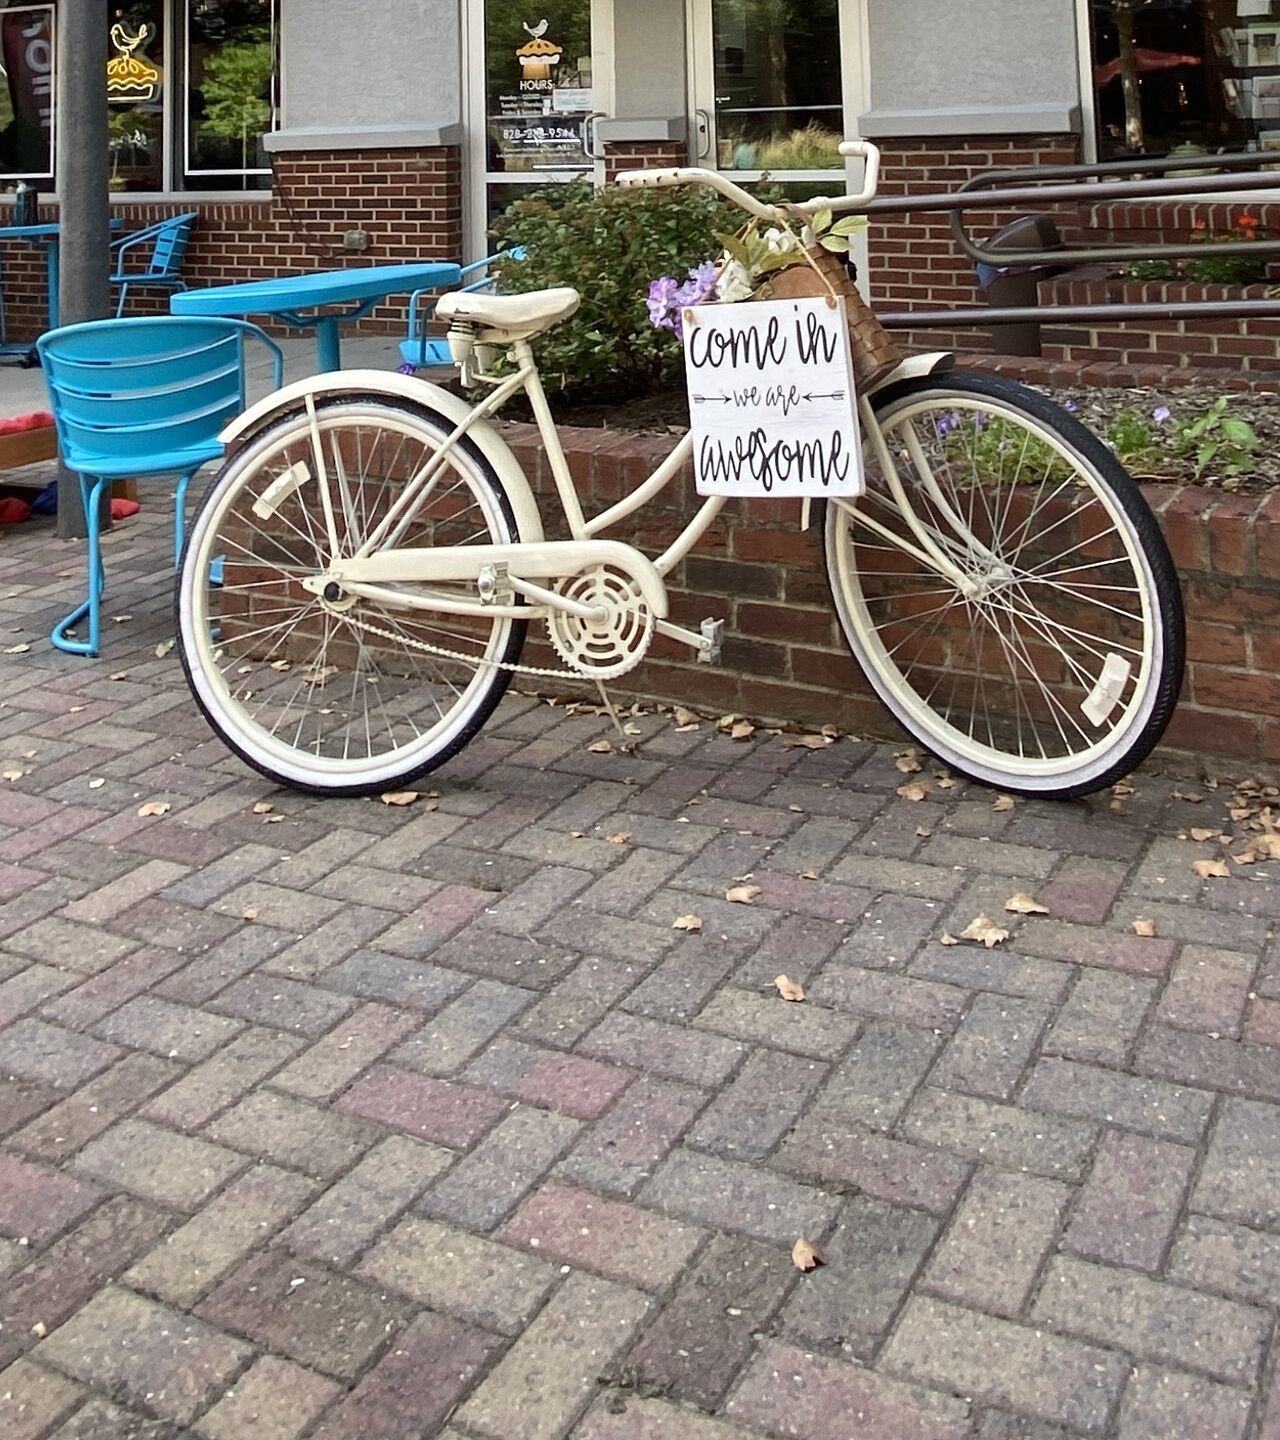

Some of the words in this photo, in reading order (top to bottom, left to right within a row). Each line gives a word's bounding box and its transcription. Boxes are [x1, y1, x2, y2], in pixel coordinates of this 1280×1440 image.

[689, 315, 787, 371] come
[793, 304, 838, 365] in
[733, 386, 762, 408] we
[765, 384, 801, 416] are
[699, 427, 850, 492] awesome
